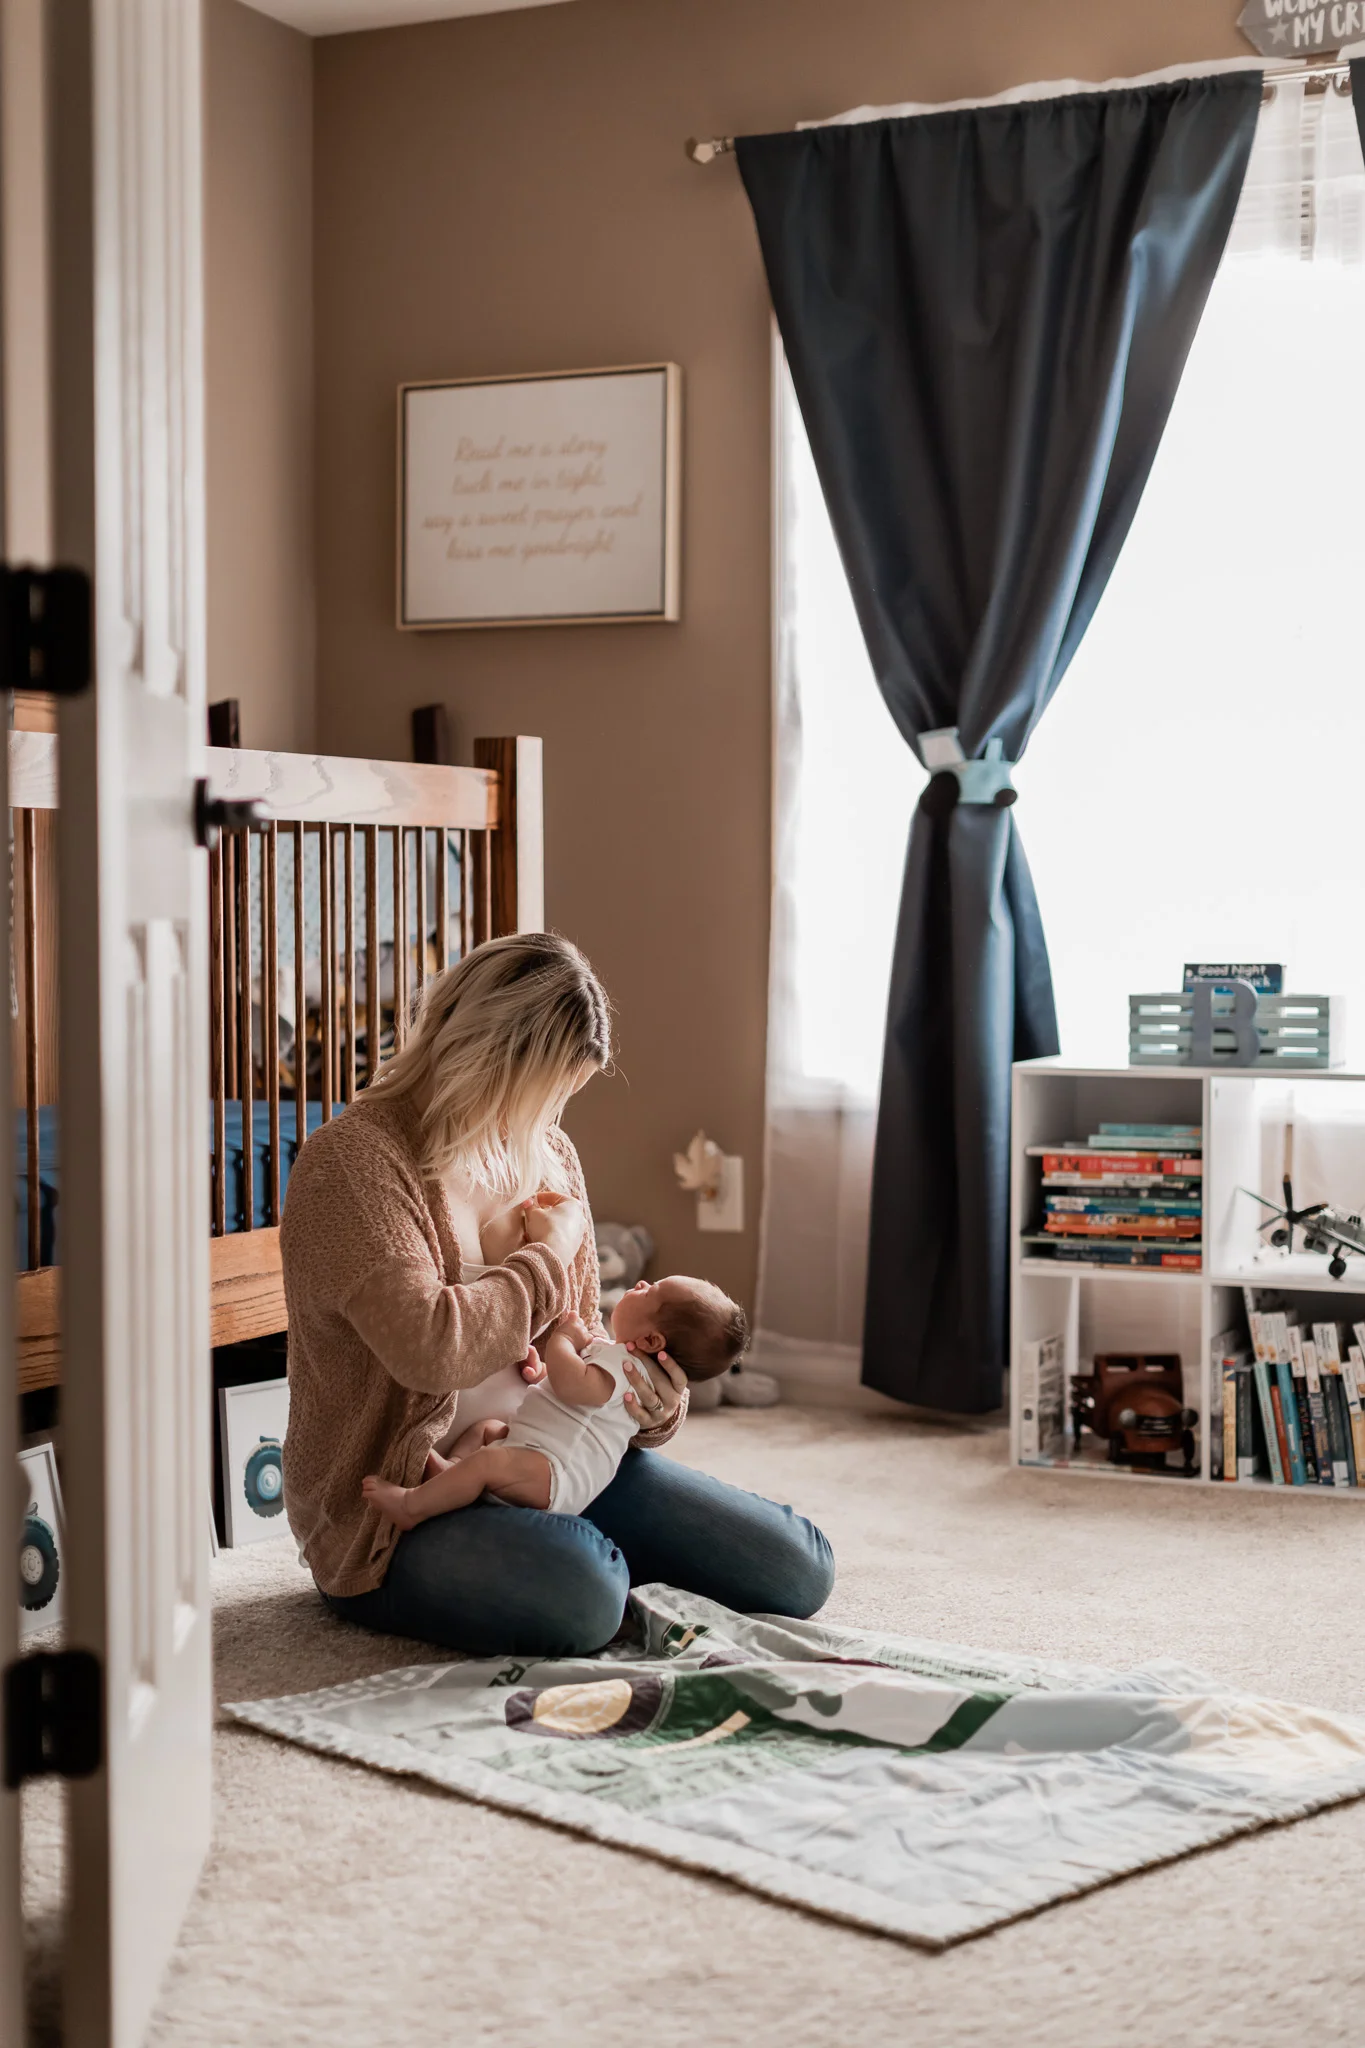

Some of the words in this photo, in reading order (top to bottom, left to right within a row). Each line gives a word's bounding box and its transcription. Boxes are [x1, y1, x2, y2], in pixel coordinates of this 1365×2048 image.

[1293, 8, 1325, 48] MY
[509, 444, 533, 456] me
[499, 477, 525, 491] me
[1198, 964, 1228, 977] Good
[1231, 964, 1267, 978] Night
[1184, 978, 1260, 1068] B
